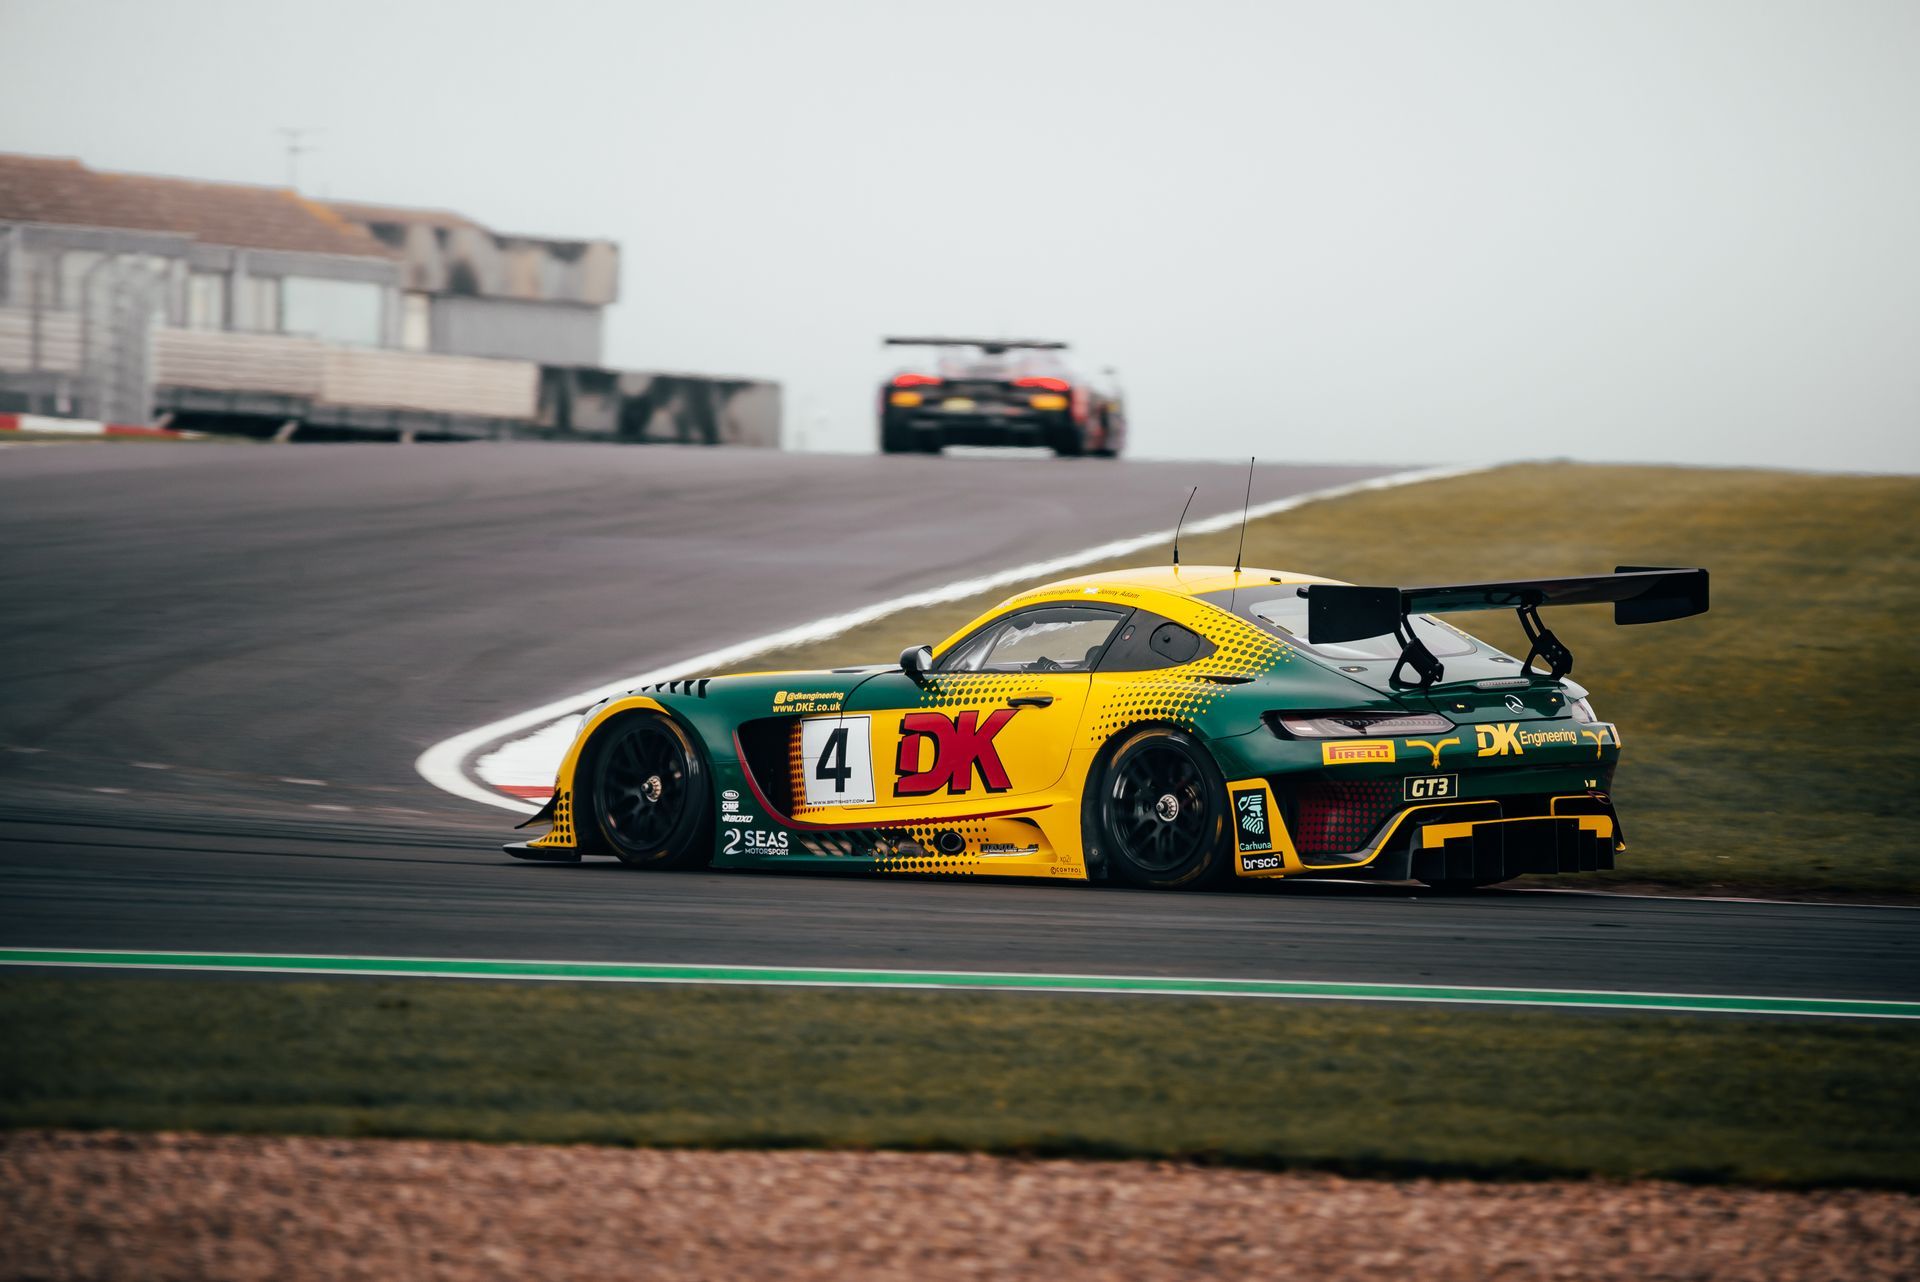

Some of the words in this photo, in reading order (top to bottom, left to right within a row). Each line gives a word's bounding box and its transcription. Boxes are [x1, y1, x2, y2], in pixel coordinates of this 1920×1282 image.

[1120, 590, 1140, 599] Adam
[786, 691, 844, 702] @dkengineering
[773, 702, 841, 712] www.DKE.co.uk
[1475, 722, 1523, 757] DK
[1519, 729, 1577, 747] Engineering
[893, 709, 1021, 798] DK
[1328, 744, 1389, 760] PIRELLI
[816, 728, 852, 792] 4
[1412, 778, 1449, 797] GT3
[744, 830, 789, 848] SEAS
[1240, 841, 1272, 851] Carhuna
[744, 848, 789, 856] MOTORSPORT
[1243, 857, 1279, 870] brscc
